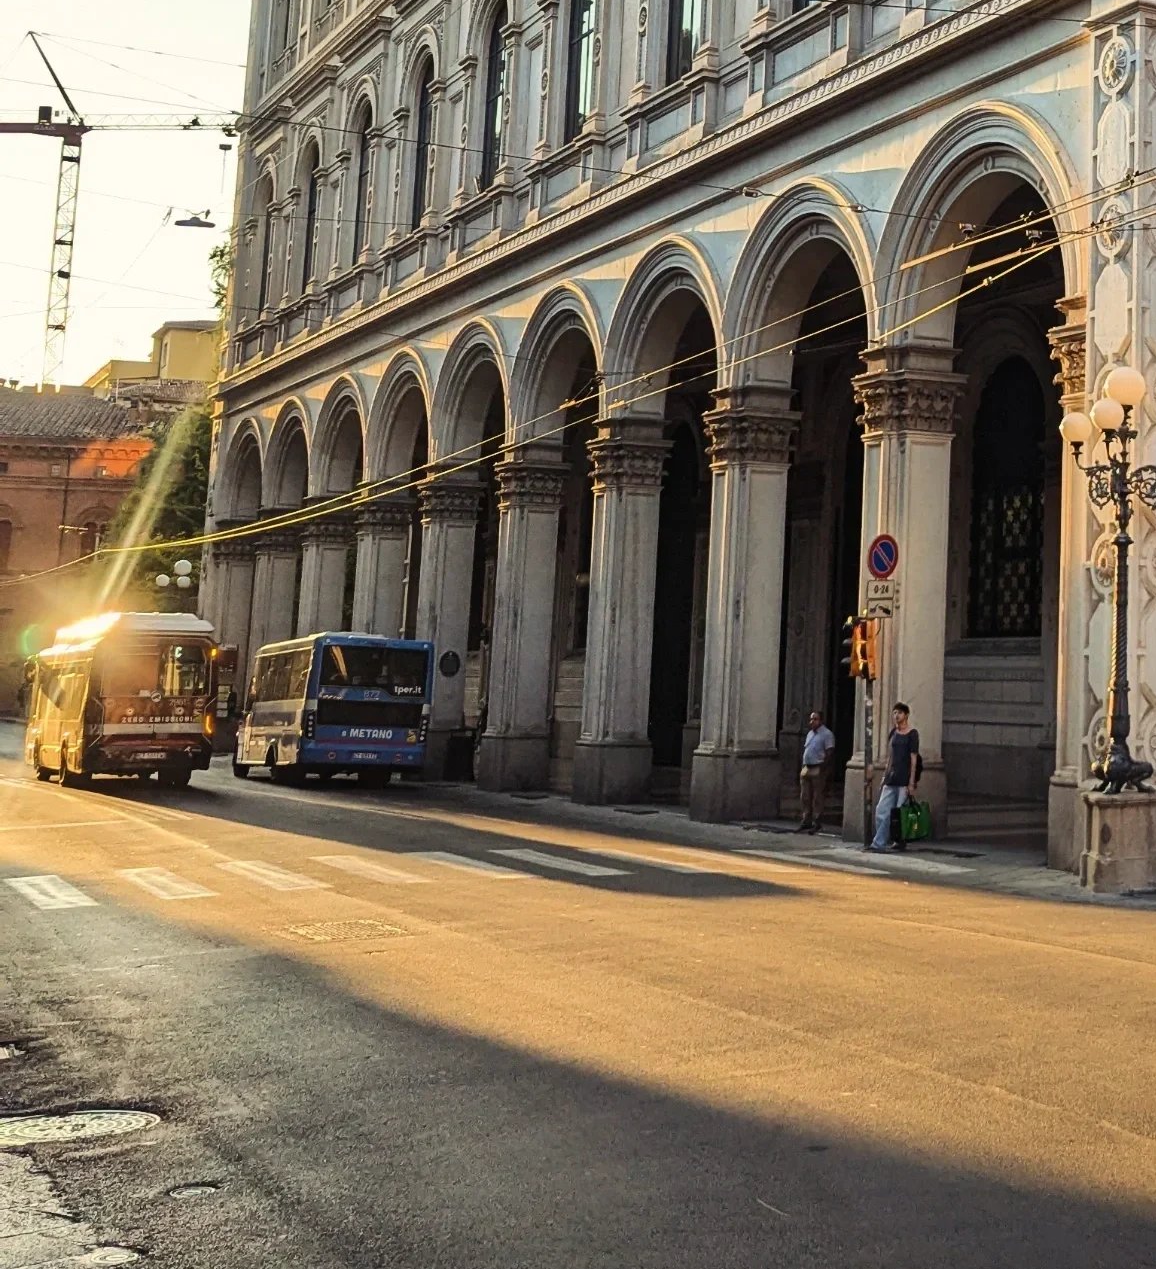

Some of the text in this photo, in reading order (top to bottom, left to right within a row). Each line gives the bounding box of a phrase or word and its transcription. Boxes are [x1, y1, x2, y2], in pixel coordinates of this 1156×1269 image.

[874, 584, 889, 594] 0-24
[174, 646, 183, 658] C
[394, 685, 422, 695] tper.it
[349, 728, 393, 740] METANO
